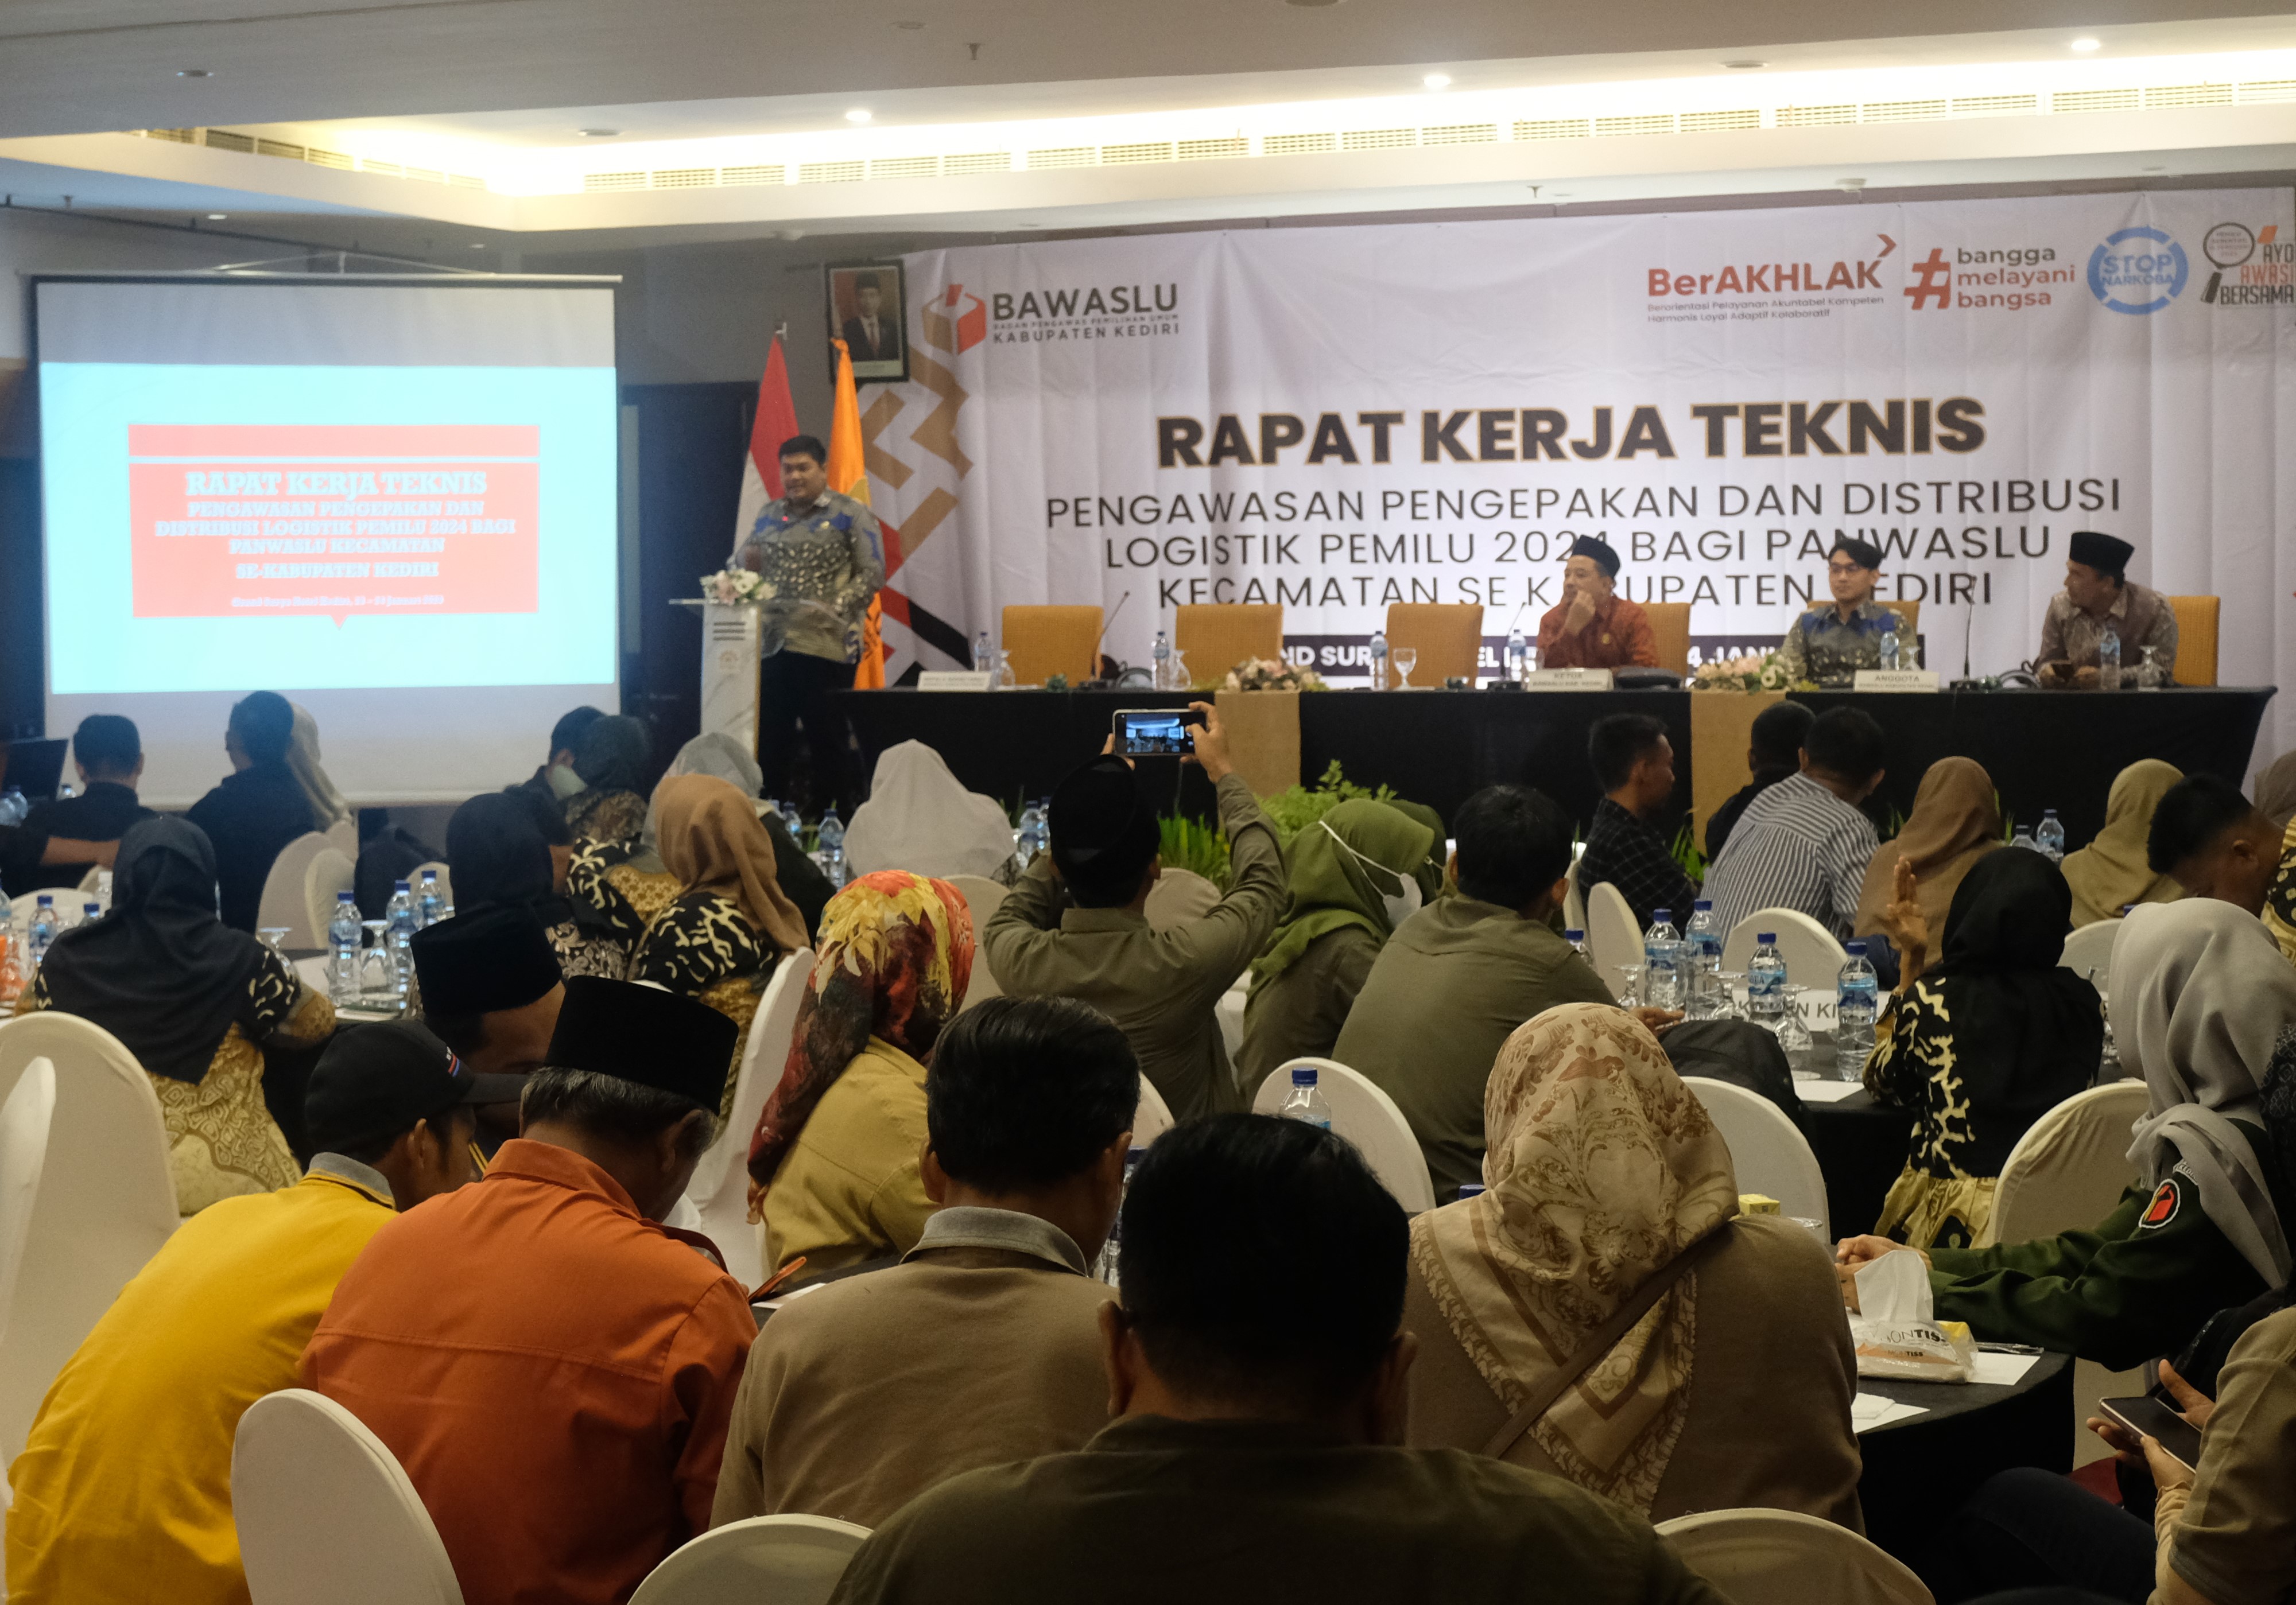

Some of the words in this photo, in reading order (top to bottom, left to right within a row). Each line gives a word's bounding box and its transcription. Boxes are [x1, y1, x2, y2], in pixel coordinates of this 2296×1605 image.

[1957, 247, 2056, 267] bangga
[2103, 254, 2174, 274] STOP
[2263, 243, 2294, 263] AYO
[1648, 260, 1883, 297] BerAKHLAK
[1957, 265, 2076, 287] melayani
[2101, 274, 2175, 286] NARKOBA
[2240, 263, 2294, 285] AWASI
[992, 283, 1178, 321] BAWASLU
[1647, 302, 1710, 312] Berorientasi
[1712, 301, 1768, 311] Pelayanan
[1771, 297, 1826, 308] Akuntabel
[1828, 296, 1884, 306] Kompeten
[1957, 291, 2052, 311] bangsa
[2220, 285, 2295, 305] BERSAMA
[1647, 313, 1698, 323] Harmonis
[1700, 312, 1728, 322] Loyal
[1730, 310, 1768, 321] Adaptif
[1771, 309, 1830, 318] Kolaboratif
[993, 327, 1107, 344] KABUPATEN
[1114, 322, 1180, 339] KEDIRI
[1157, 410, 1406, 468] RAPAT
[1420, 404, 1677, 464] KERJA
[1690, 397, 1987, 461] TEKNIS
[186, 472, 281, 496] RAPAT
[287, 472, 379, 500] KERJA
[381, 471, 487, 495] TEKNIS
[1047, 490, 1365, 529] PENGAWASAN
[1382, 486, 1698, 523] PENGEPAKAN
[1720, 483, 1822, 518] DAN
[1843, 477, 2120, 516] DISTRIBUSI
[429, 519, 468, 534] 2024
[1107, 534, 1301, 569] LOGISTIK
[1320, 531, 1476, 565] PEMILU
[1631, 529, 1746, 562] BAGI
[1159, 576, 1438, 609] KECAMATAN
[1458, 576, 1507, 607] SE
[1527, 574, 1813, 607] KUPATEN
